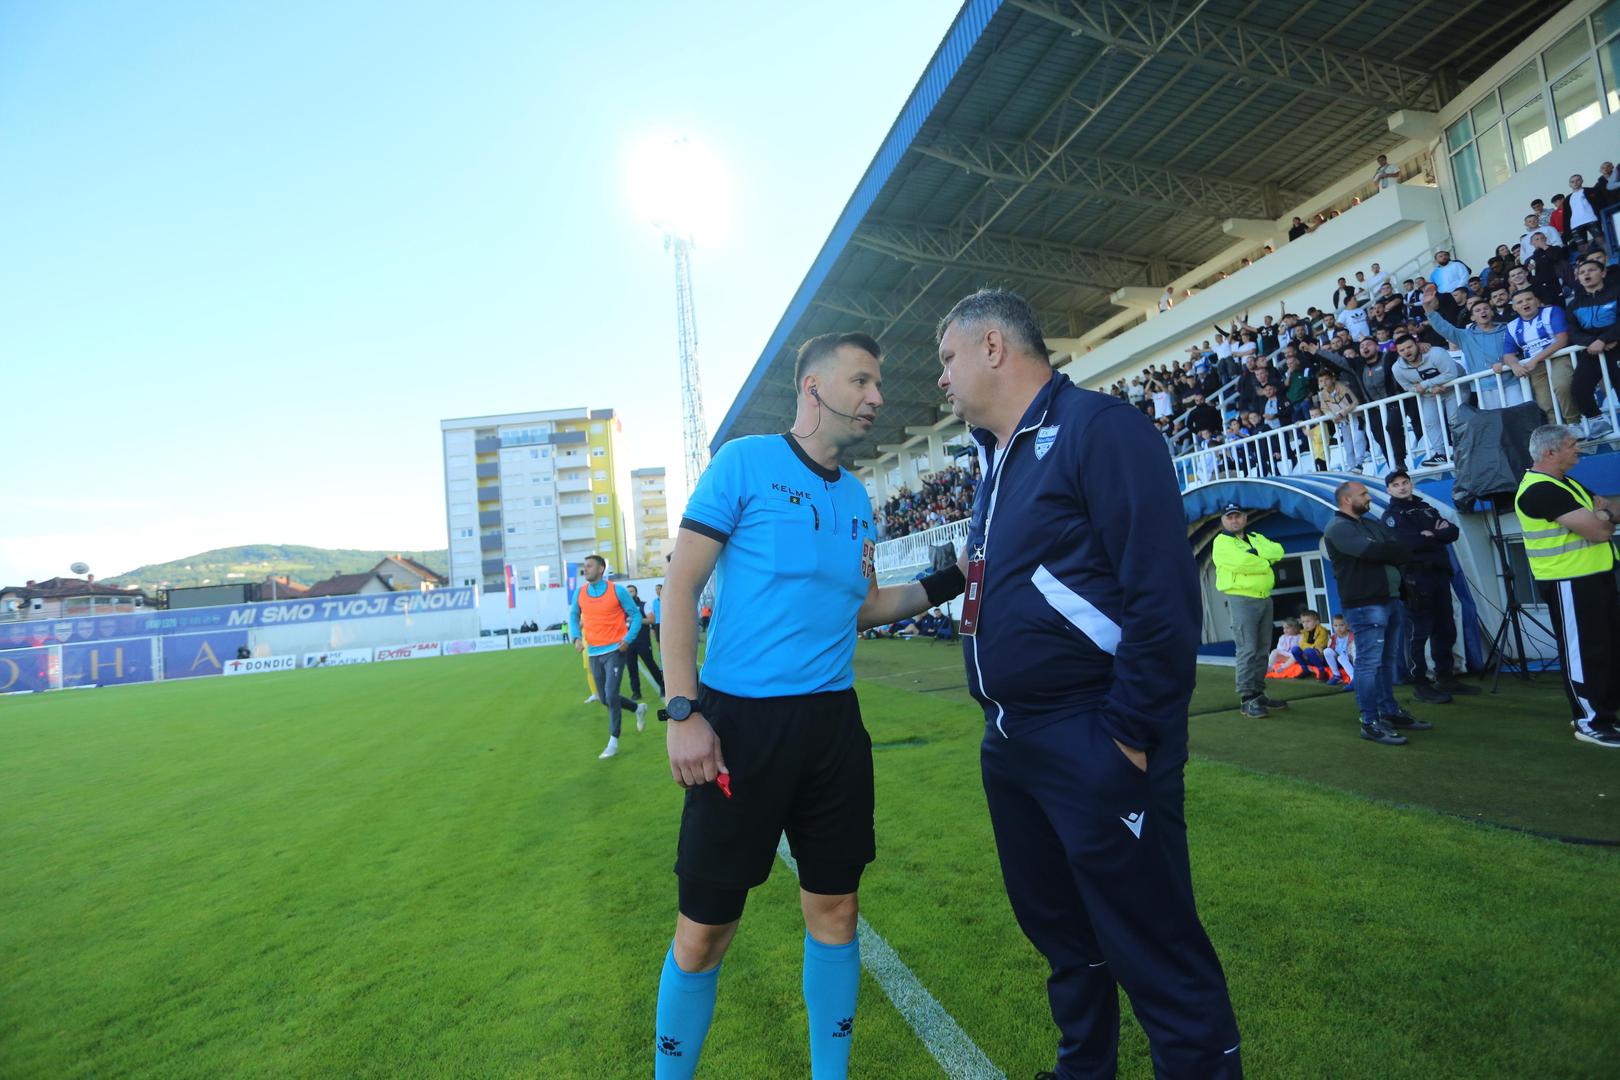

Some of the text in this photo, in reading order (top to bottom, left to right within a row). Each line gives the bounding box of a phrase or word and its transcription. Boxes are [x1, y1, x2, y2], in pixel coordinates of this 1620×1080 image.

[771, 483, 812, 499] KELME
[227, 610, 257, 626] MI
[261, 605, 314, 624] SMO
[320, 598, 387, 618] TVOJI
[392, 591, 470, 612] SINOVI!
[417, 642, 439, 650] SAN
